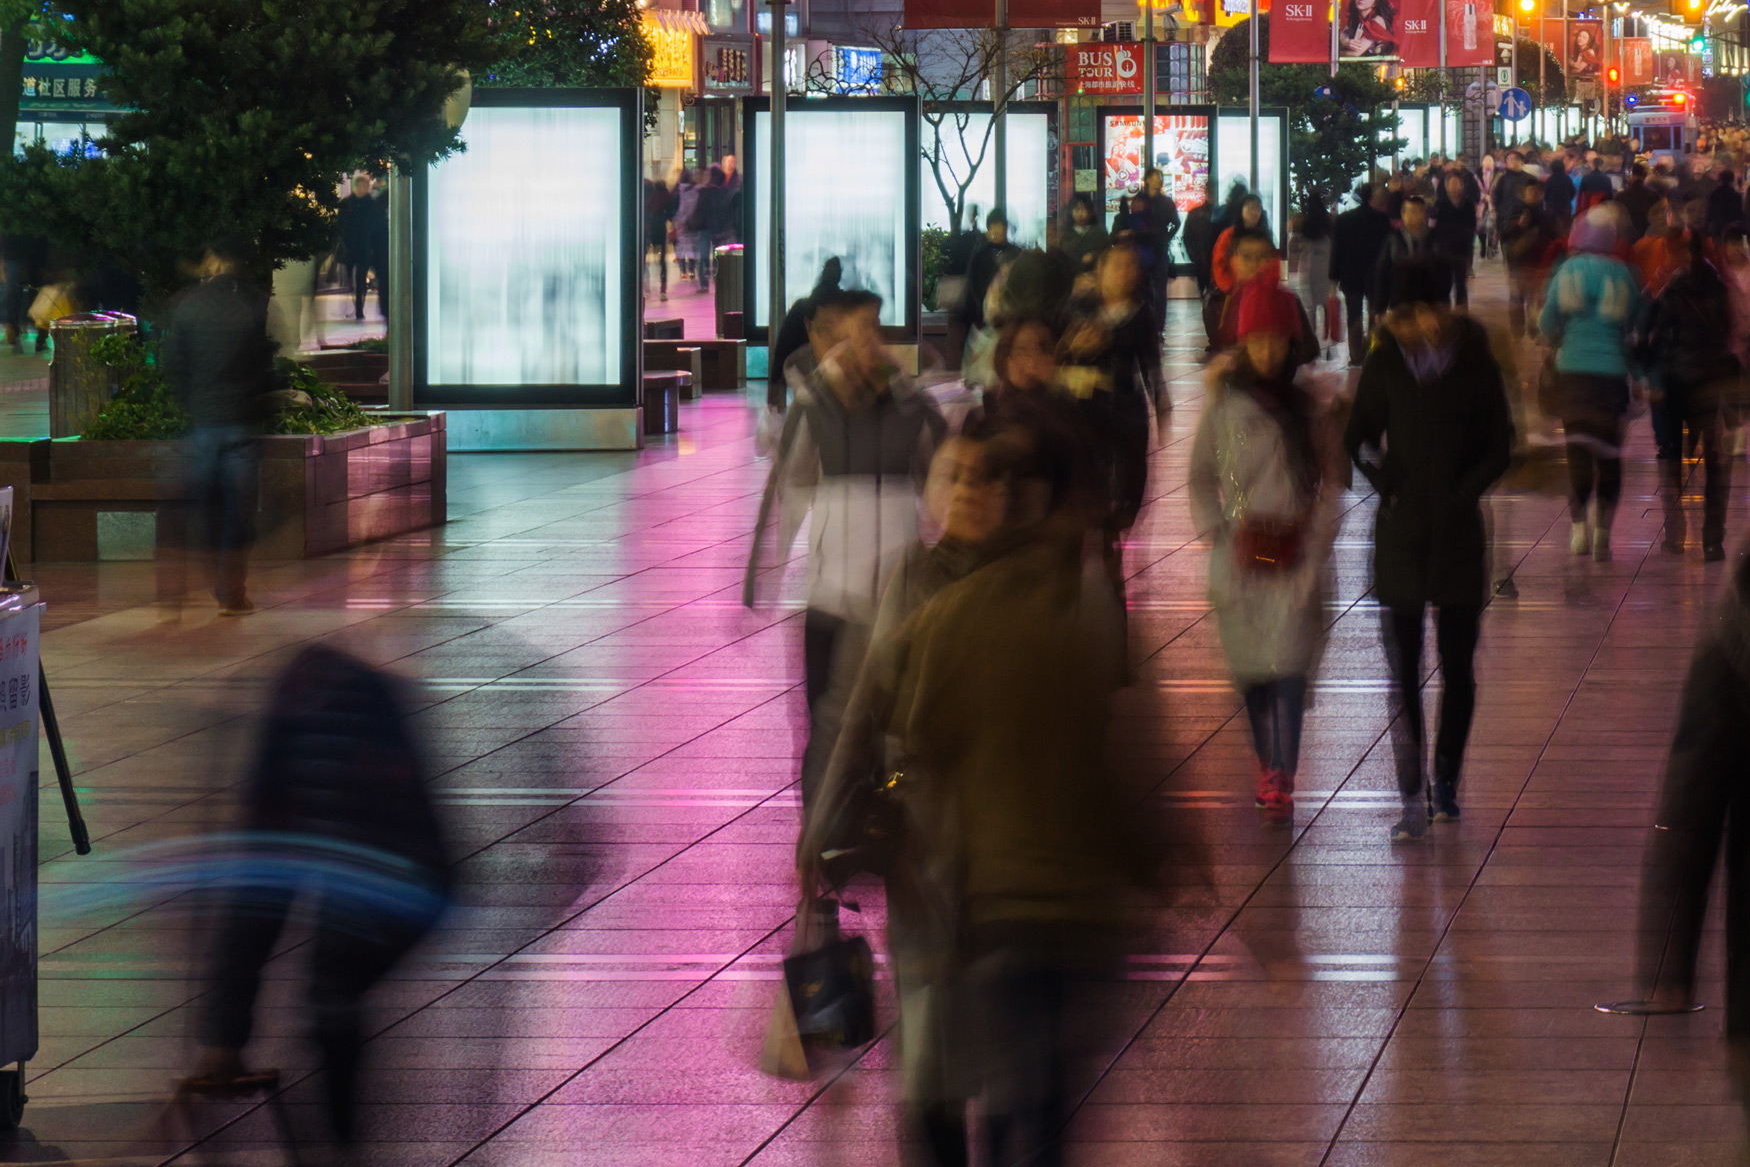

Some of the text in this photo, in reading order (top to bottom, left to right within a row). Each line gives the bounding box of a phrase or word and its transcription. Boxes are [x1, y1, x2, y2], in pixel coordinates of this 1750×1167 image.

[1285, 4, 1313, 17] SK-II
[1405, 19, 1427, 30] SK-II
[1078, 51, 1113, 66] BUS
[1078, 67, 1114, 78] TOUR
